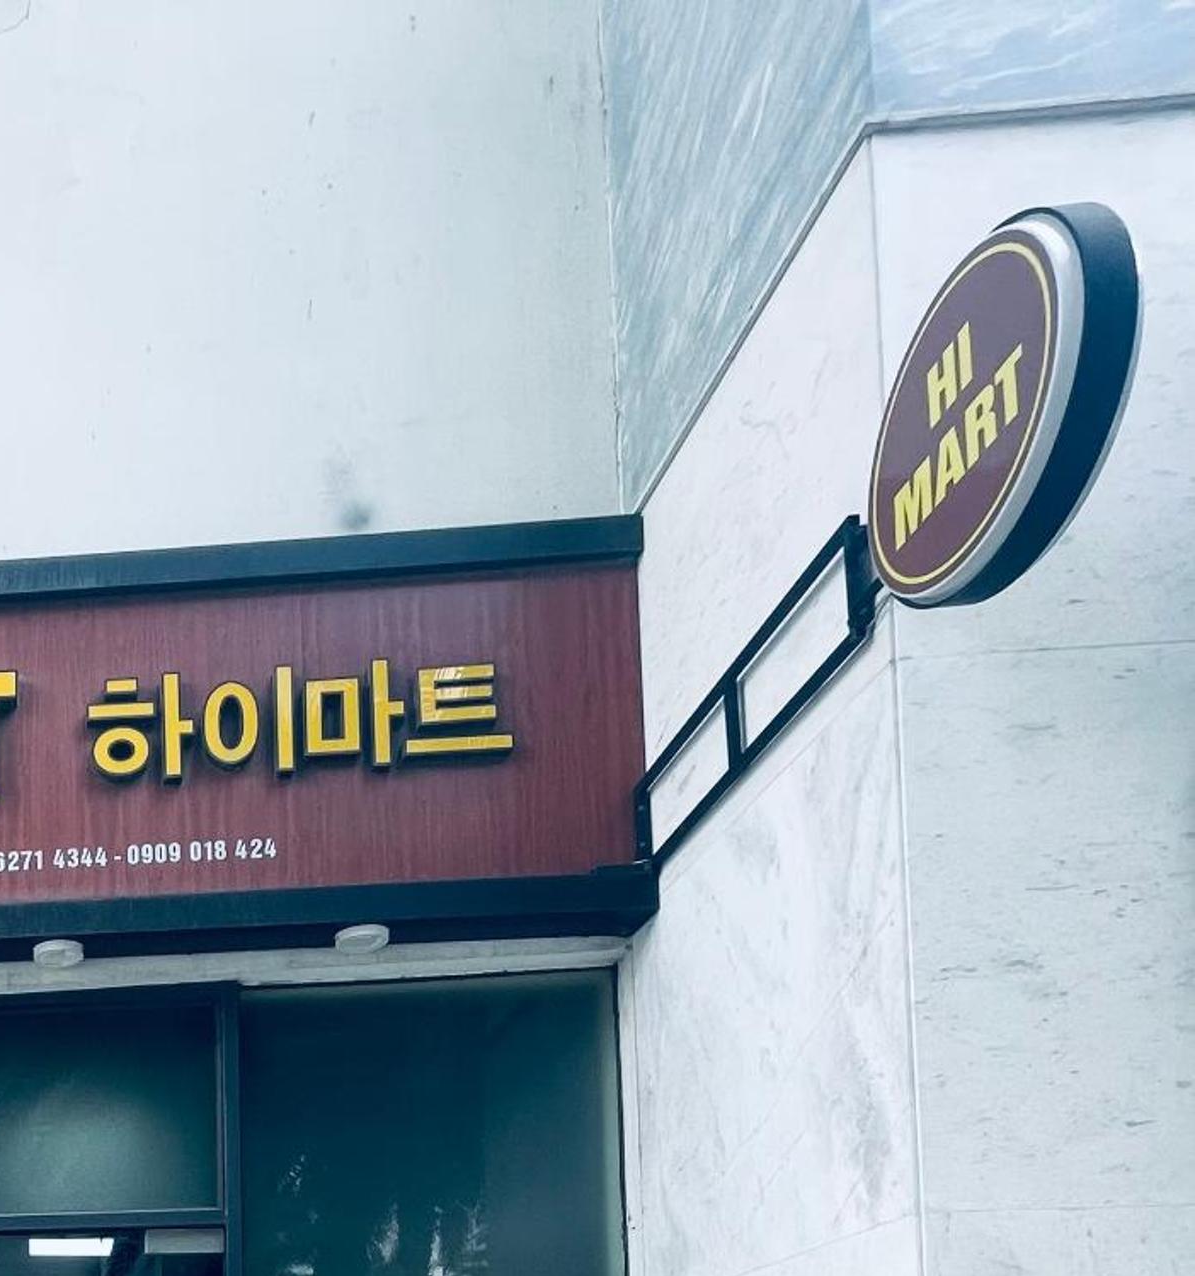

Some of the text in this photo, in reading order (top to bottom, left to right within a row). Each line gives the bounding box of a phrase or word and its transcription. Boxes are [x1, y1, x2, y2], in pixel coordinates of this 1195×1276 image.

[927, 321, 973, 429] HI
[893, 343, 1023, 551] MART
[86, 658, 515, 782] 하이마트
[53, 845, 107, 868] 4344
[127, 844, 181, 865] 0909
[189, 841, 227, 861] 018
[235, 838, 277, 859] 424
